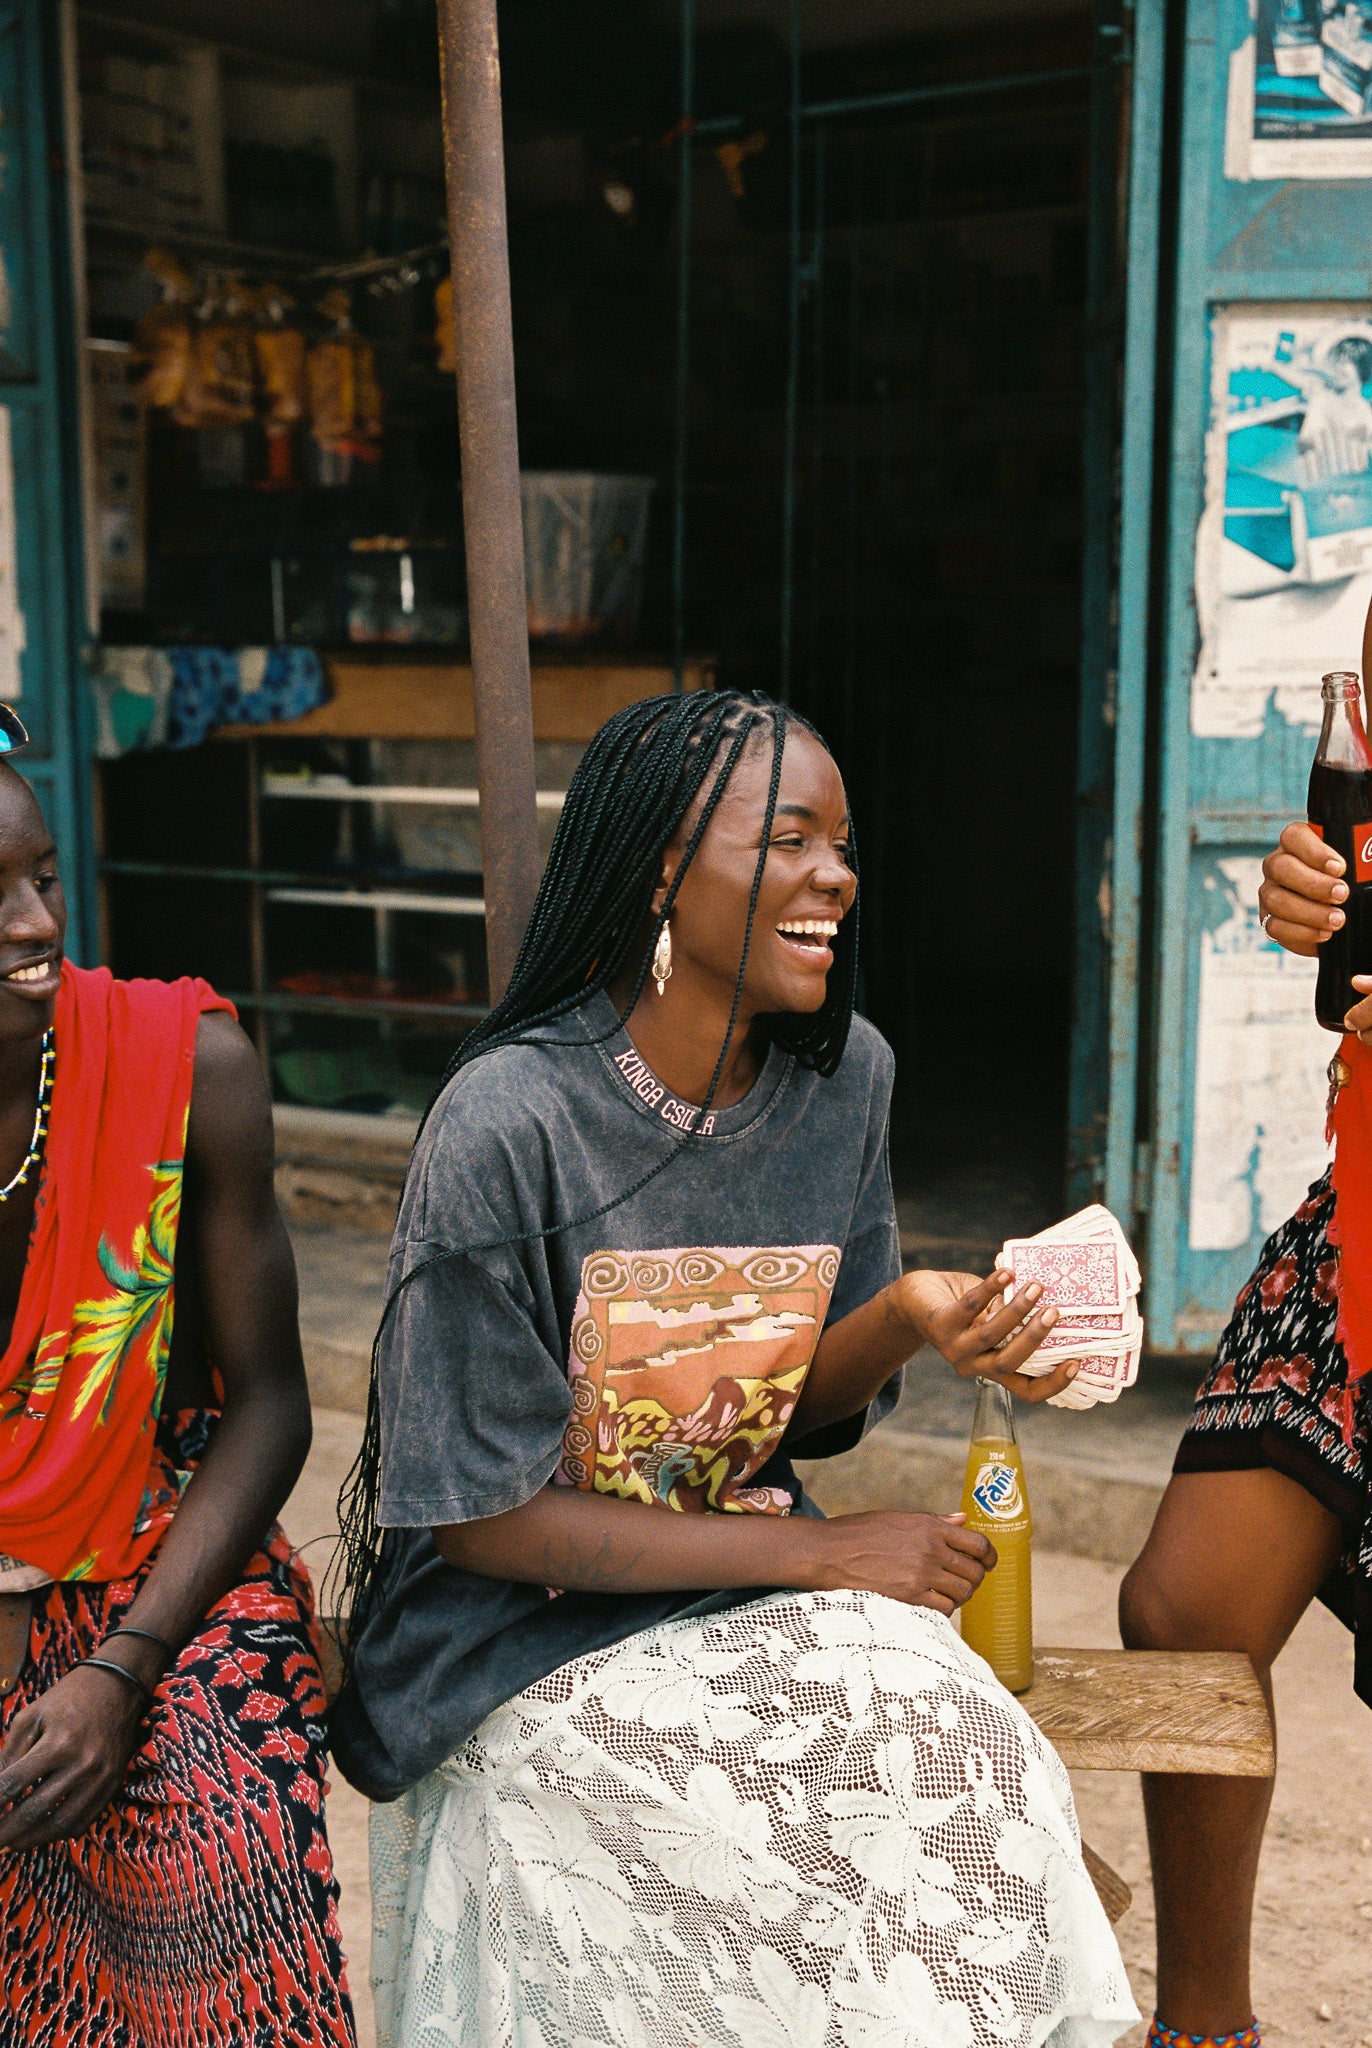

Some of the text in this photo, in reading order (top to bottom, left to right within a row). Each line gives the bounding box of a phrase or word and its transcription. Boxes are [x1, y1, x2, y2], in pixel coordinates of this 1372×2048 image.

[614, 1048, 715, 1136] KINGA CSILA
[973, 1468, 1015, 1514] Fanta
